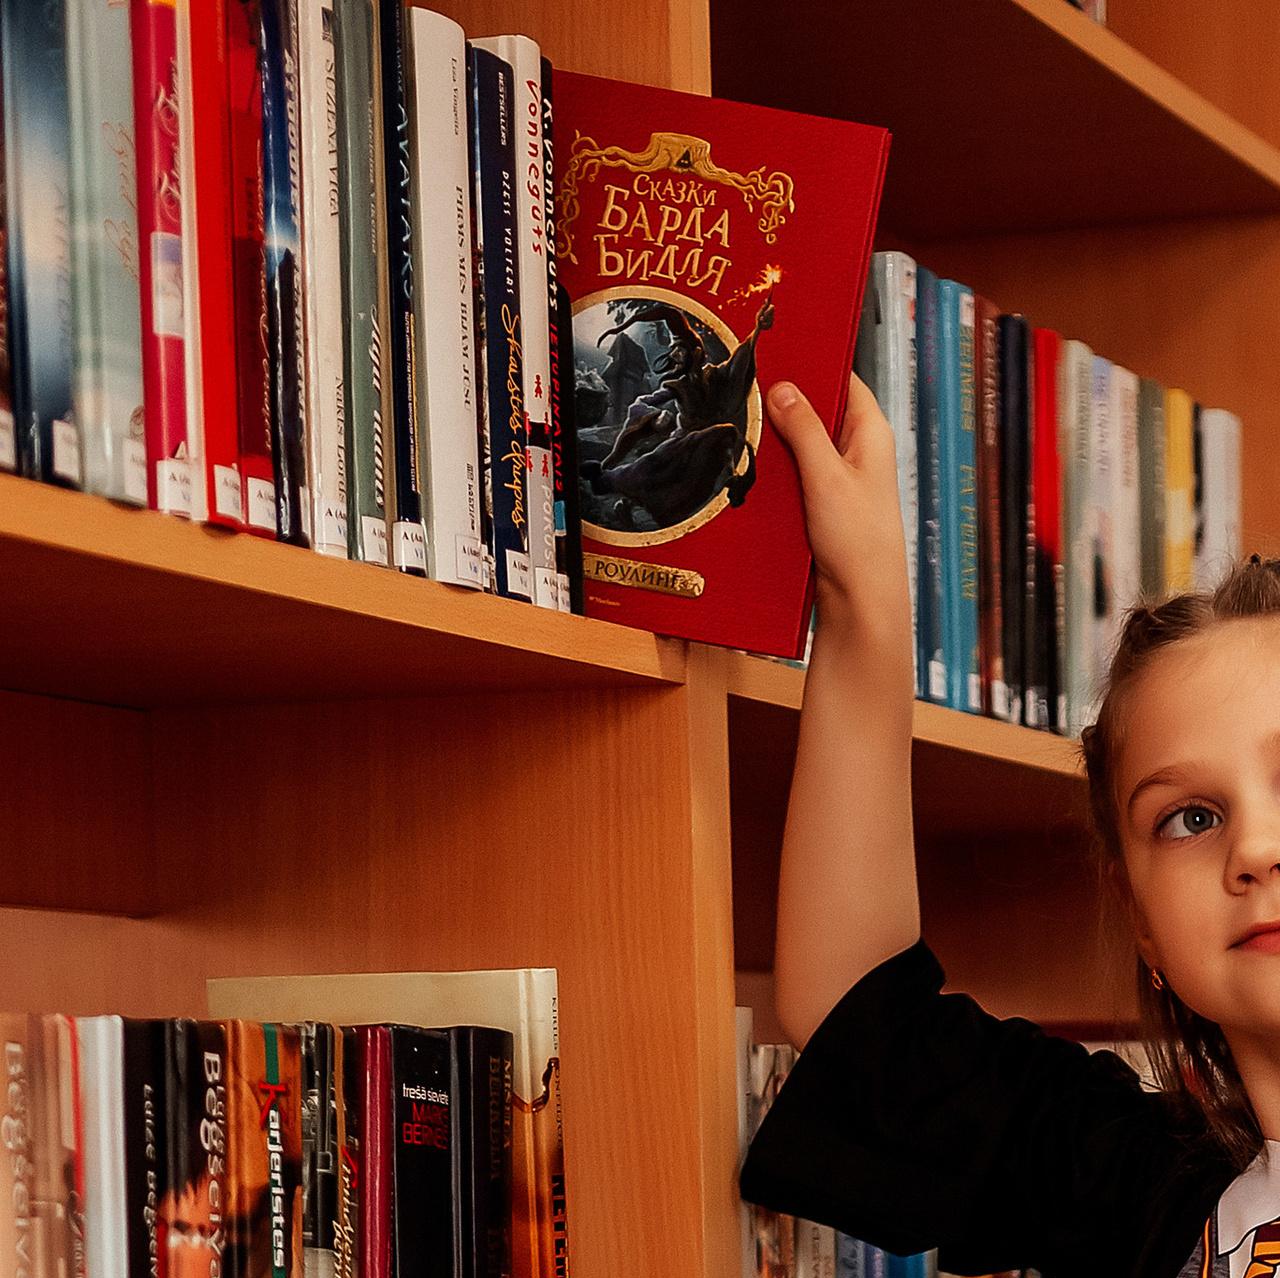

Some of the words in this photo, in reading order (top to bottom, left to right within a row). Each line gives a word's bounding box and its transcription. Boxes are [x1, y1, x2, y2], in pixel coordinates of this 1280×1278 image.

[456, 185, 467, 248] PIRMS
[596, 183, 731, 248] БАРДА
[592, 232, 733, 297] БИДЛЯ
[259, 1078, 289, 1269] Karjeristes
